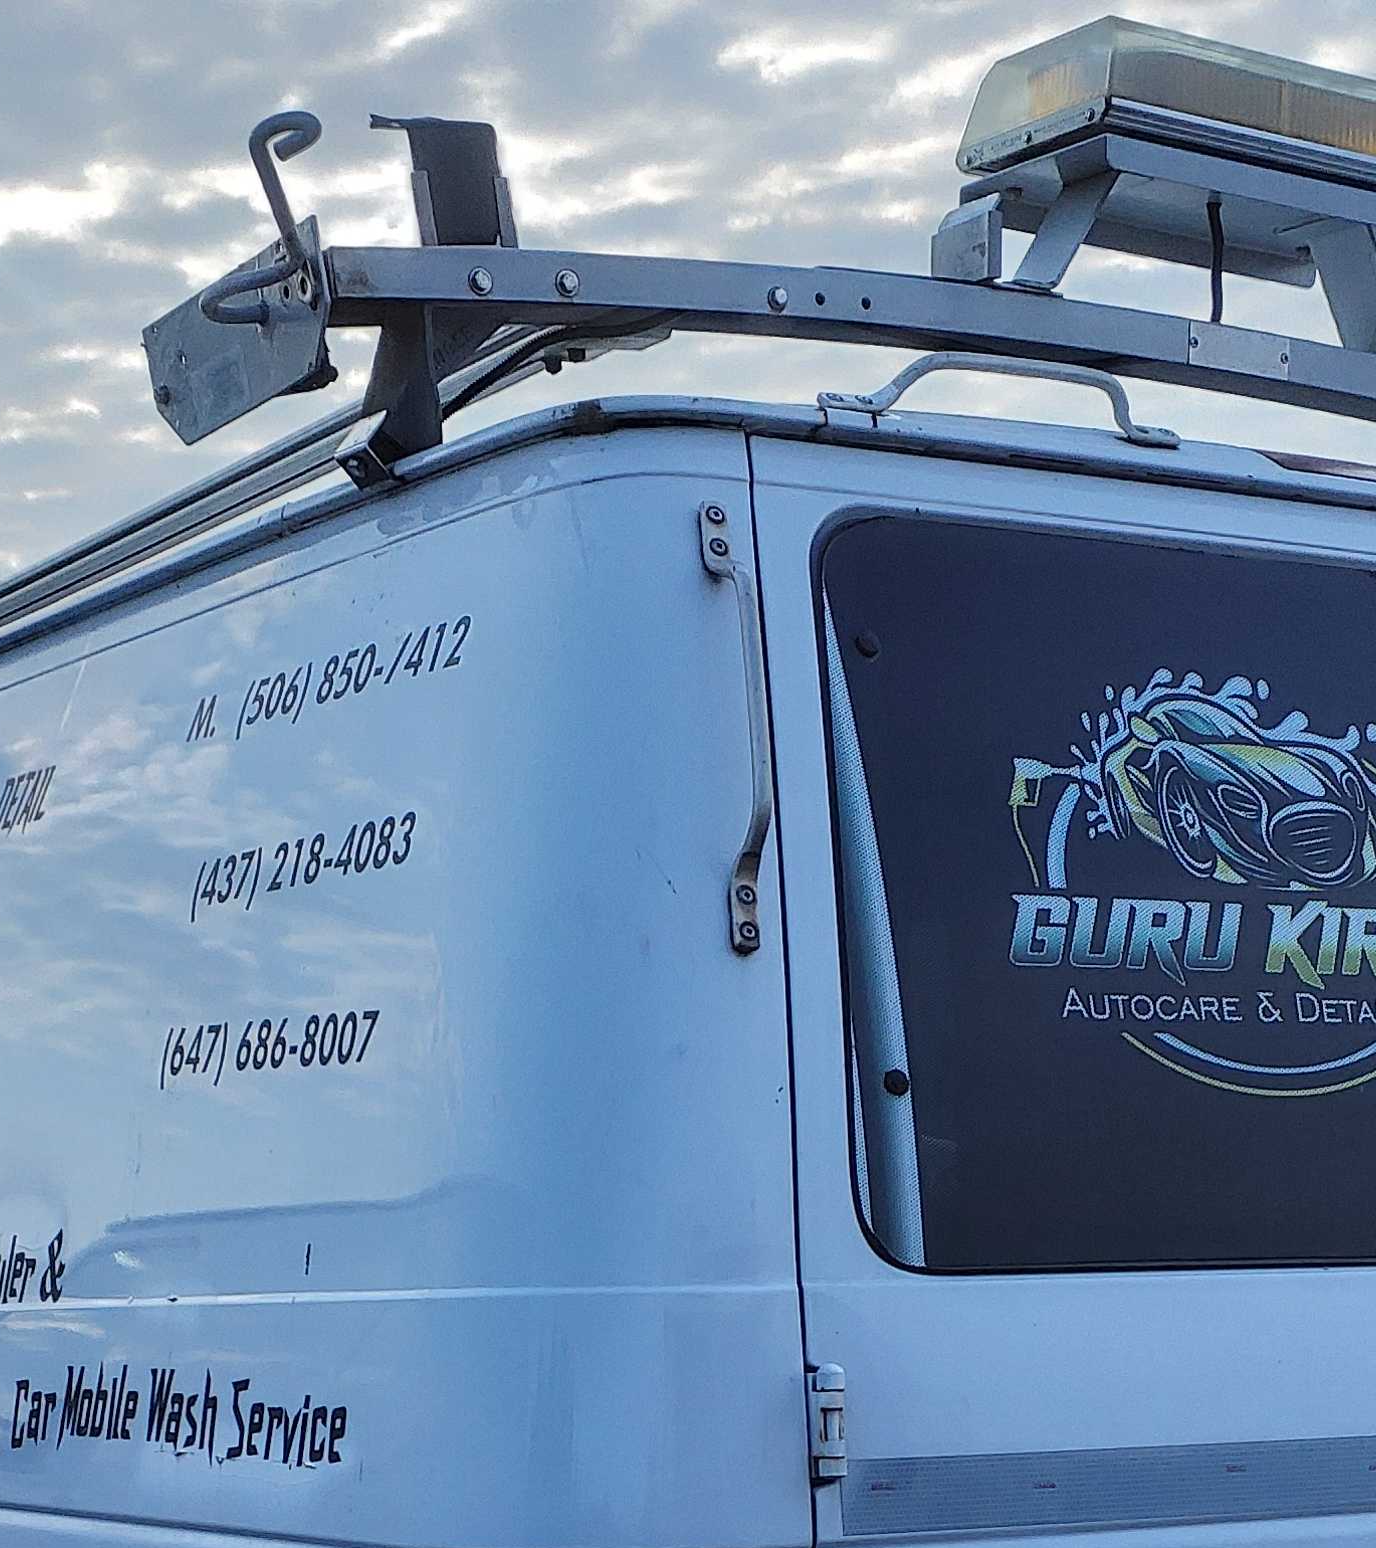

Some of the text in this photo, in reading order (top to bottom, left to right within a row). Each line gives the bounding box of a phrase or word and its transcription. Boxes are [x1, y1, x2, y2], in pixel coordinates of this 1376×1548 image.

[186, 694, 217, 742] M.
[235, 661, 313, 740] (506)
[190, 811, 417, 923] (437) 218-4083
[1007, 892, 1244, 988] GURU
[1256, 991, 1284, 1024] &
[159, 1009, 380, 1090] (647) 686-8007
[38, 1227, 66, 1304] &
[10, 1360, 347, 1468] Car Mobile Wash Service
